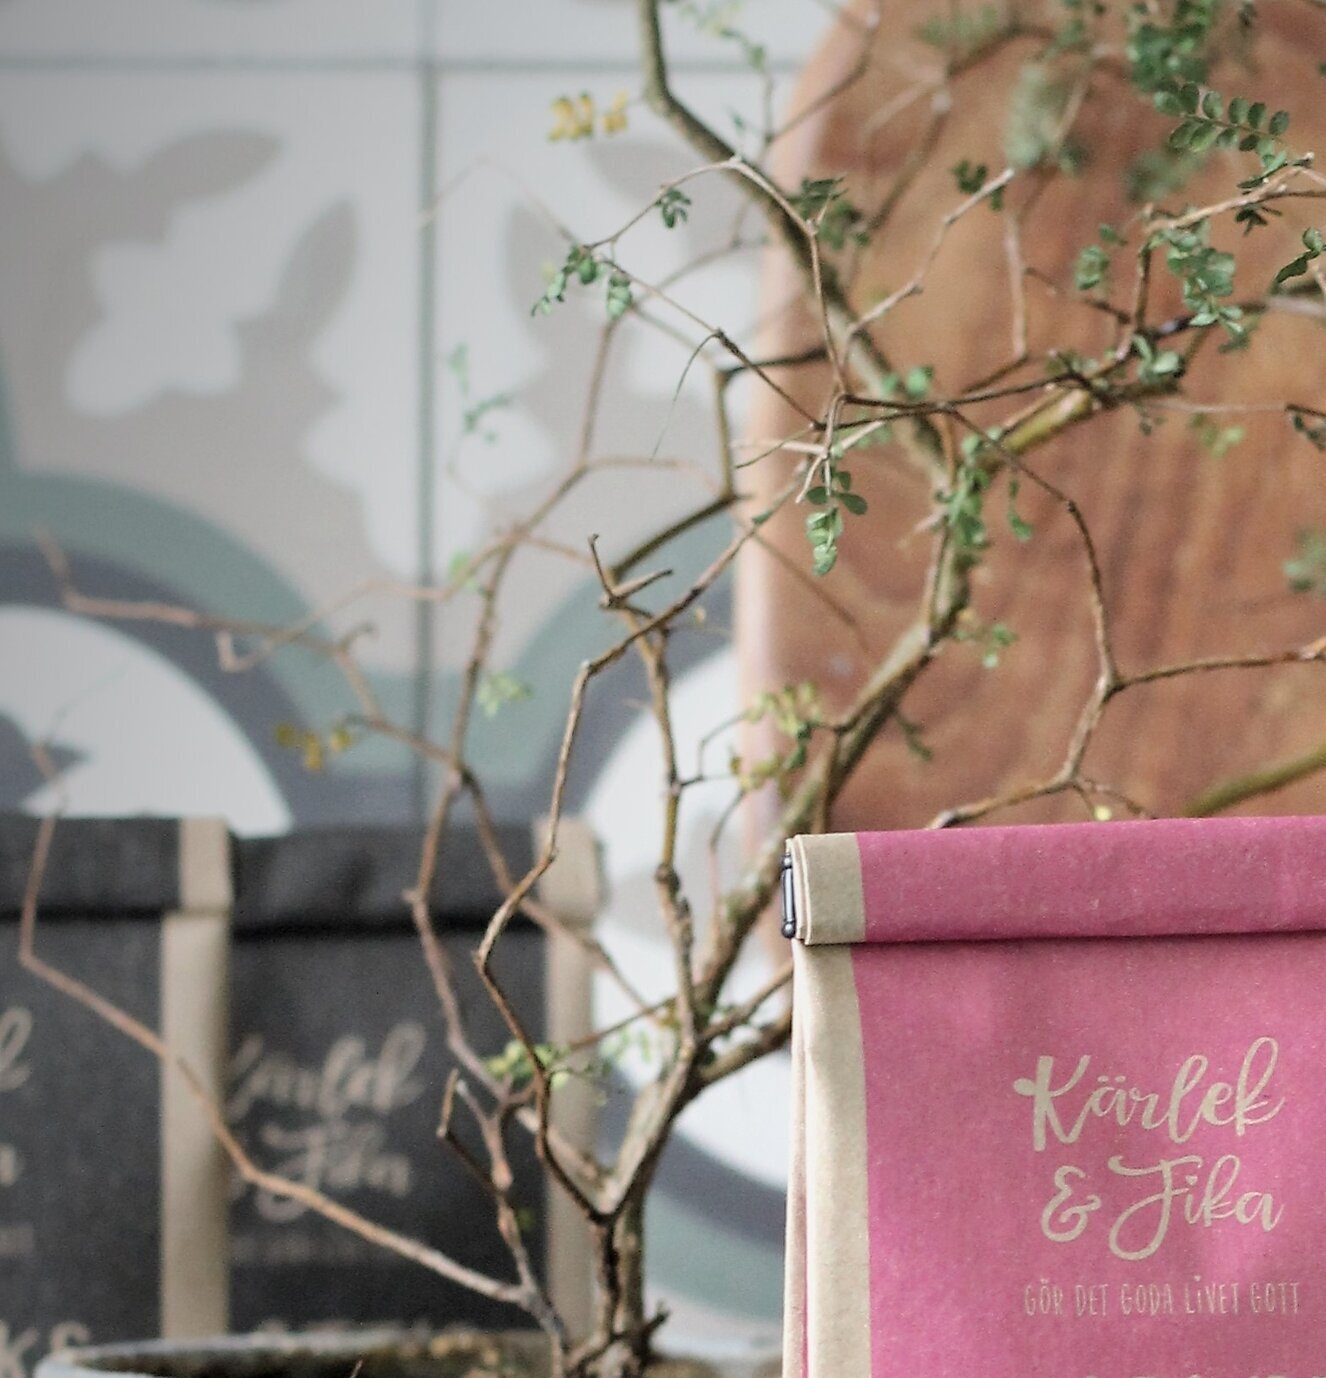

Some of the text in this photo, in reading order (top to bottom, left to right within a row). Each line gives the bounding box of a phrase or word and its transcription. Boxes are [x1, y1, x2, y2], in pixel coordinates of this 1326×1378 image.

[1013, 1037, 1285, 1151] Kärlek
[1041, 1154, 1285, 1260] & Fika
[1024, 1277, 1064, 1316] GÖR
[1076, 1284, 1108, 1316] DET
[1121, 1283, 1173, 1316] GODA
[1250, 1282, 1299, 1314] GOTT
